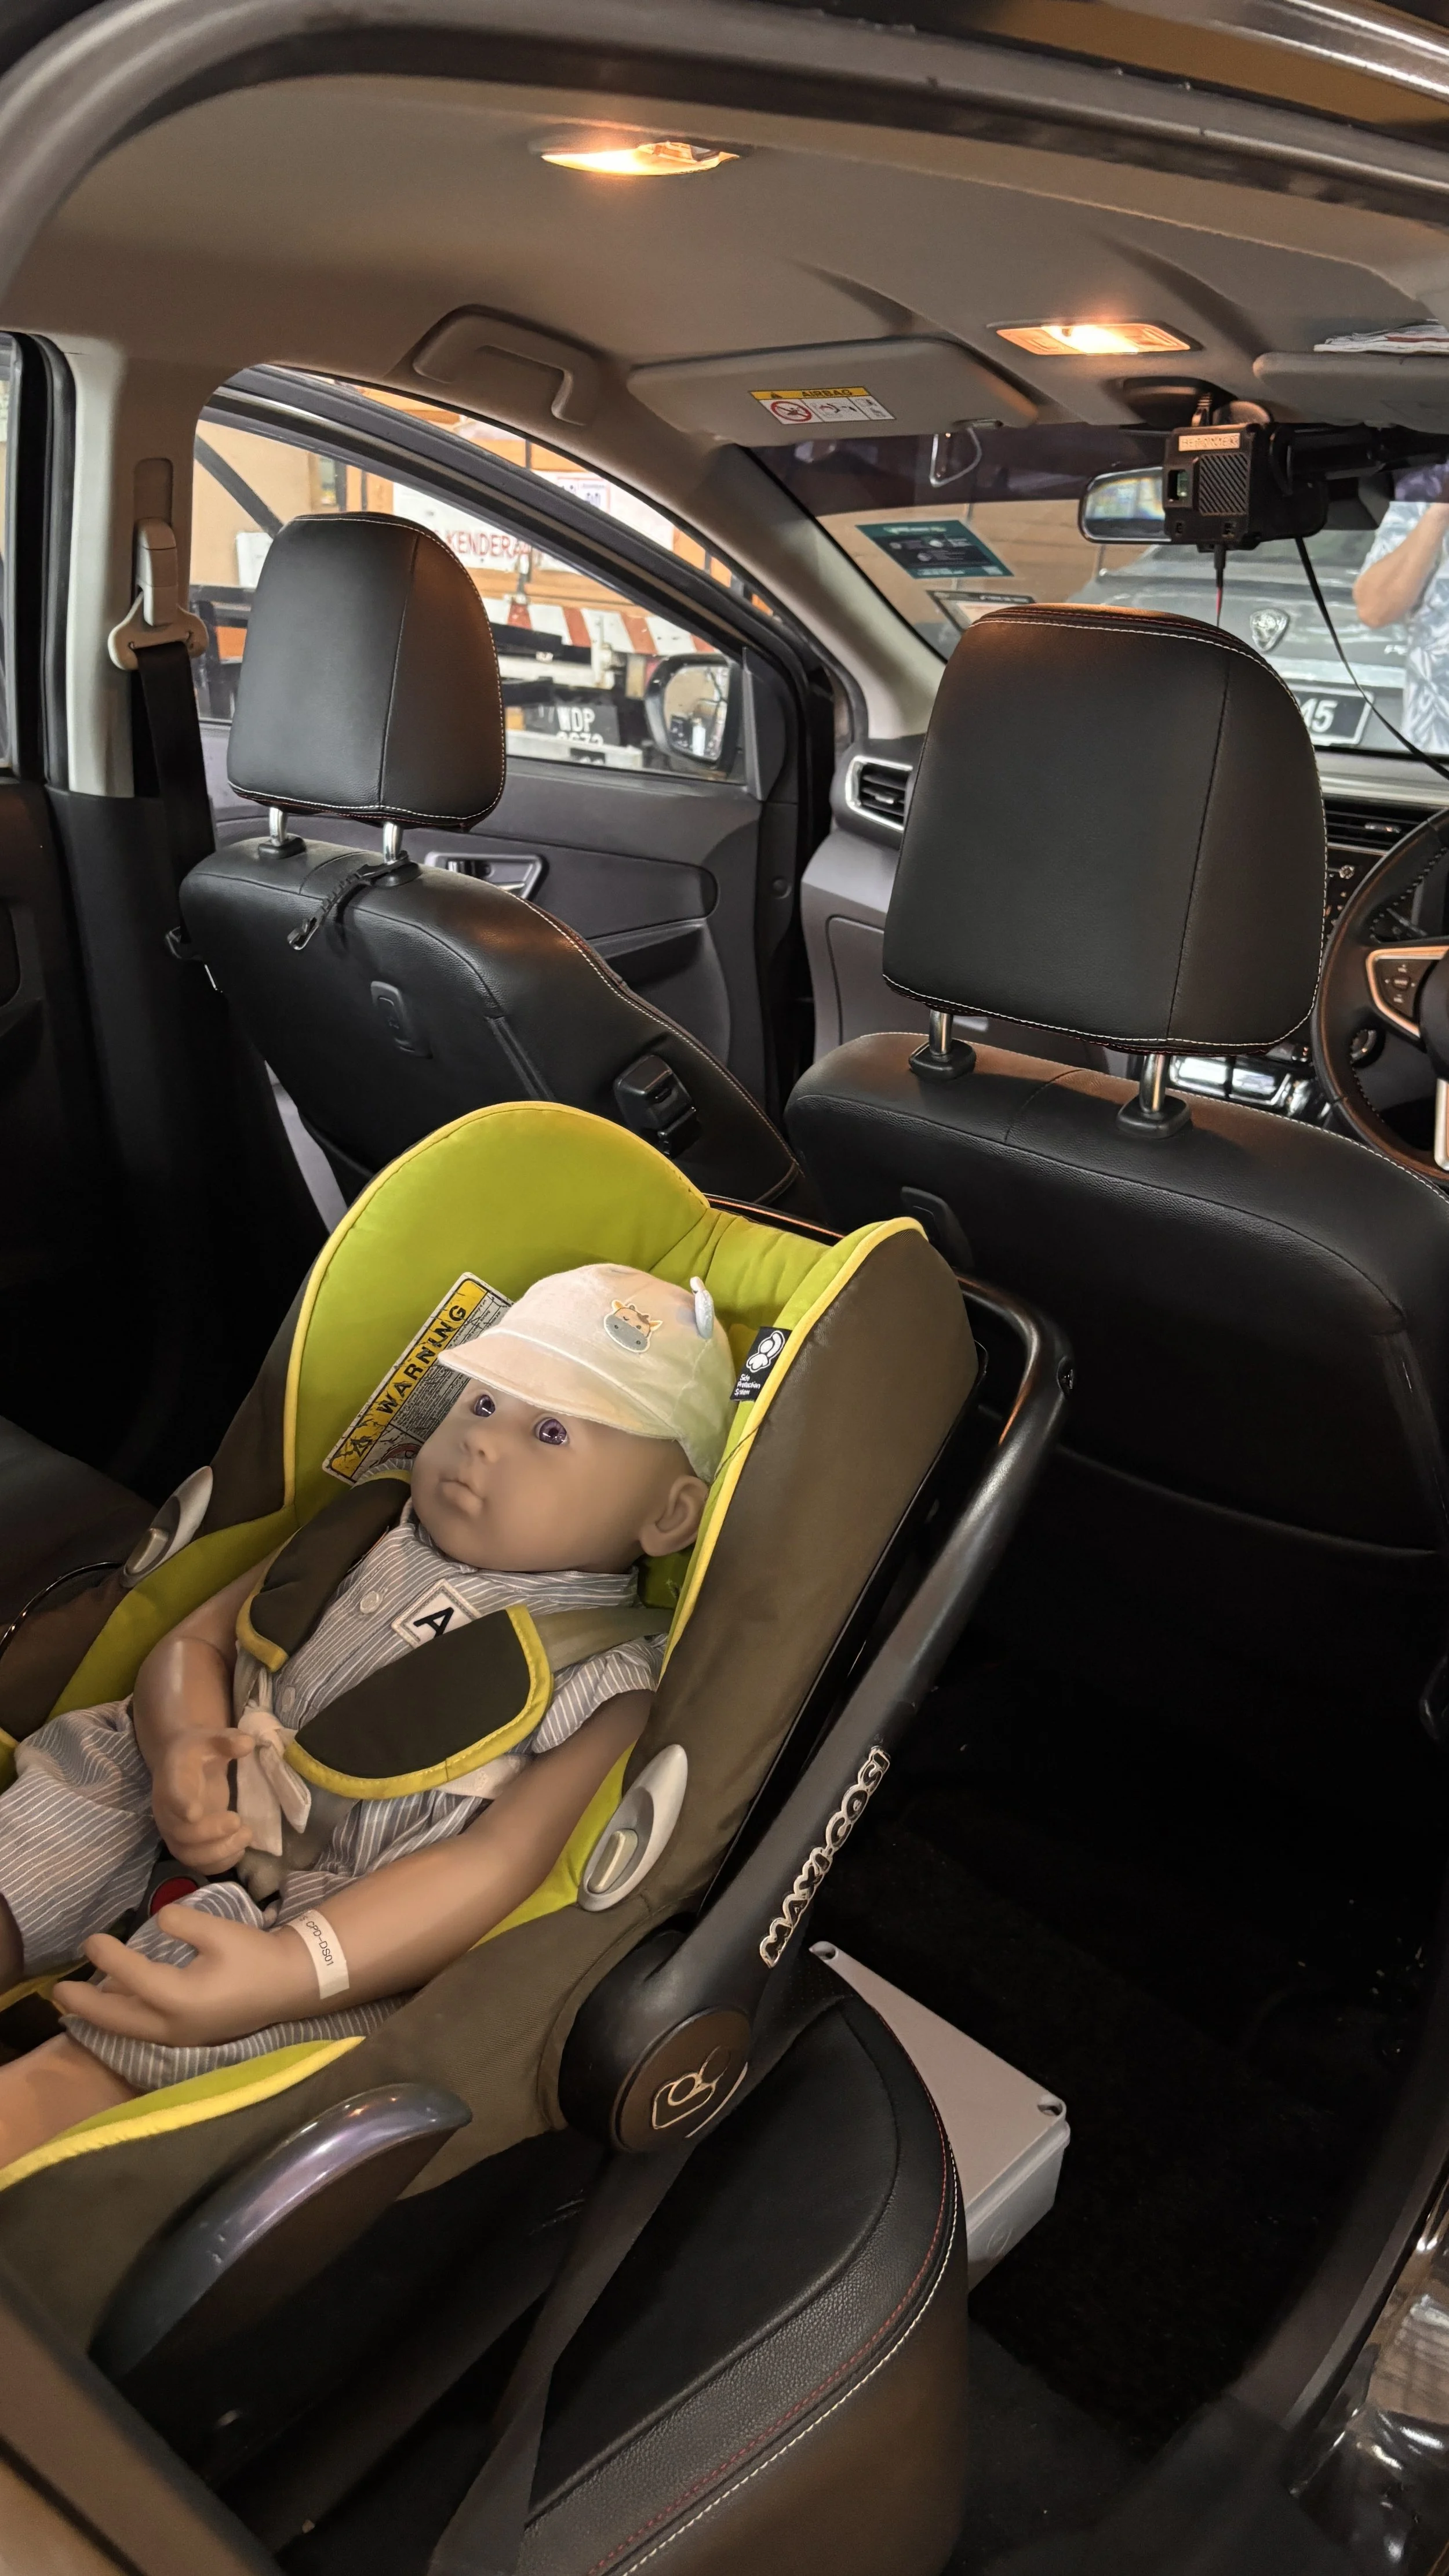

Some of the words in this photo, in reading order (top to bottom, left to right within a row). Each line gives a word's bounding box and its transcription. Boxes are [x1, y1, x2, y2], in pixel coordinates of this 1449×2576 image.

[802, 389, 853, 398] AIRBAG
[556, 706, 595, 733] WDP
[377, 1305, 466, 1414] WARNING
[413, 1606, 454, 1638] A
[305, 1920, 334, 1966] CPD-DS01
